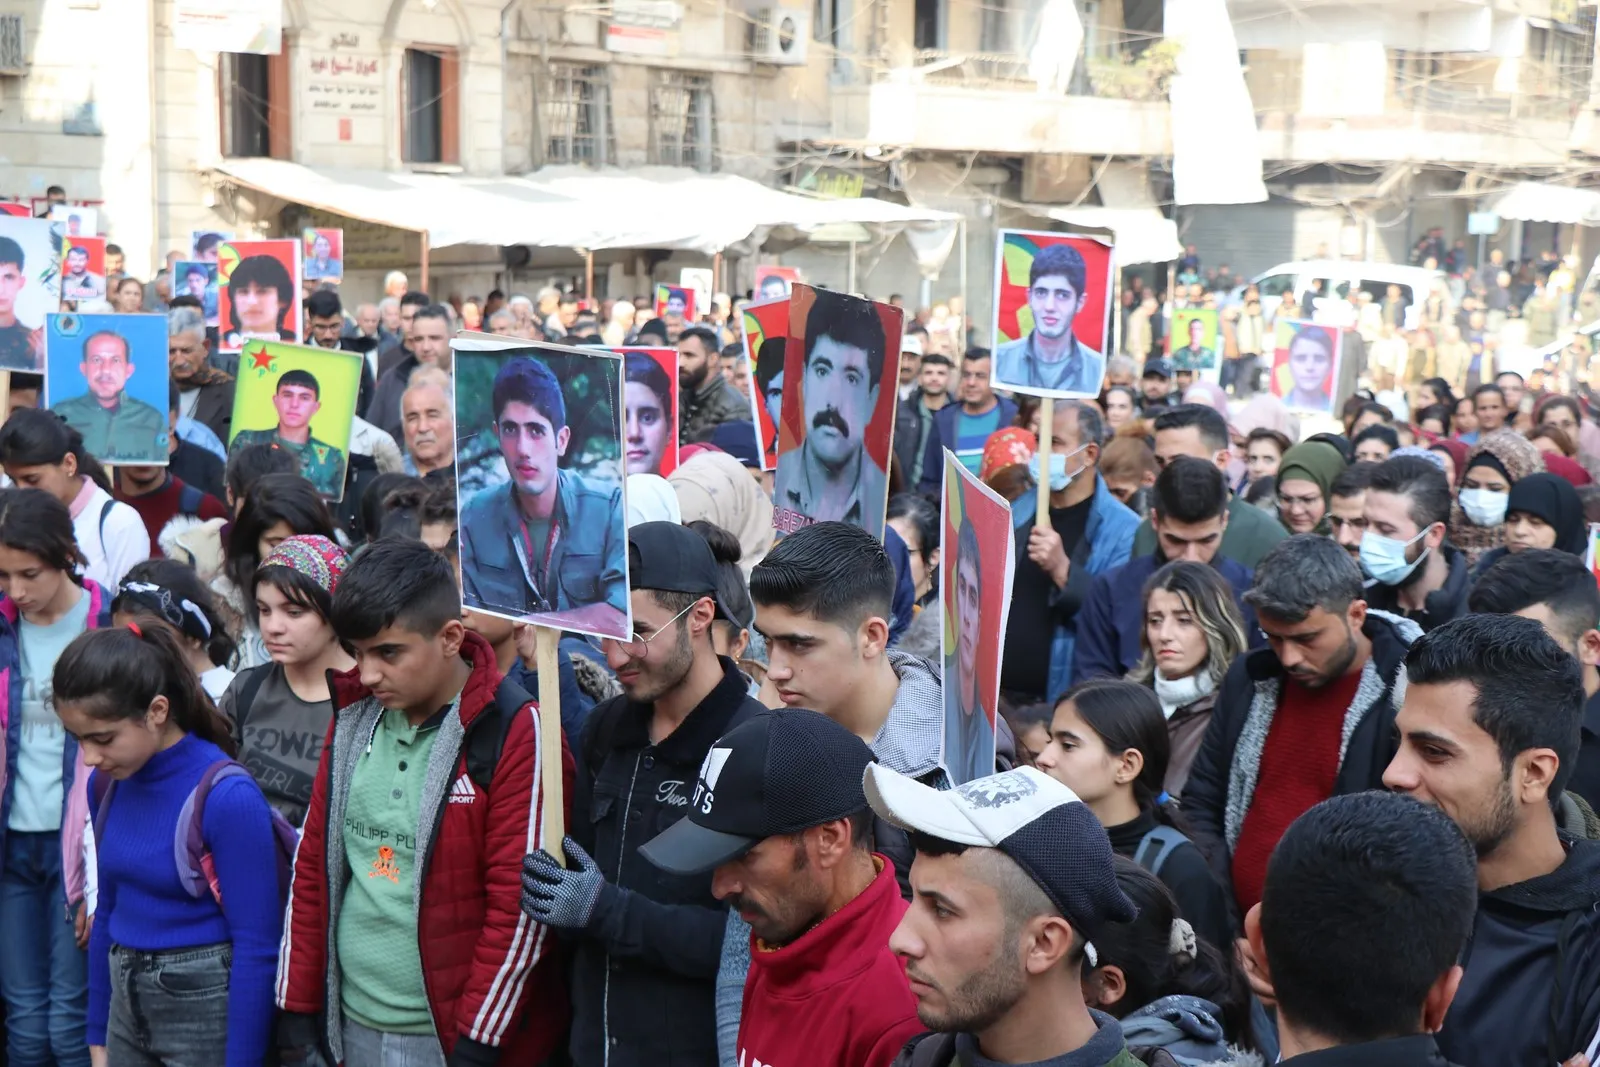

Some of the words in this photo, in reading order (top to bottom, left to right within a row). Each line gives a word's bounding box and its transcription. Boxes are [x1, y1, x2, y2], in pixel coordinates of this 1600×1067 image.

[449, 796, 475, 804] SPORT
[655, 780, 688, 807] Two
[345, 818, 389, 842] PHILIPP
